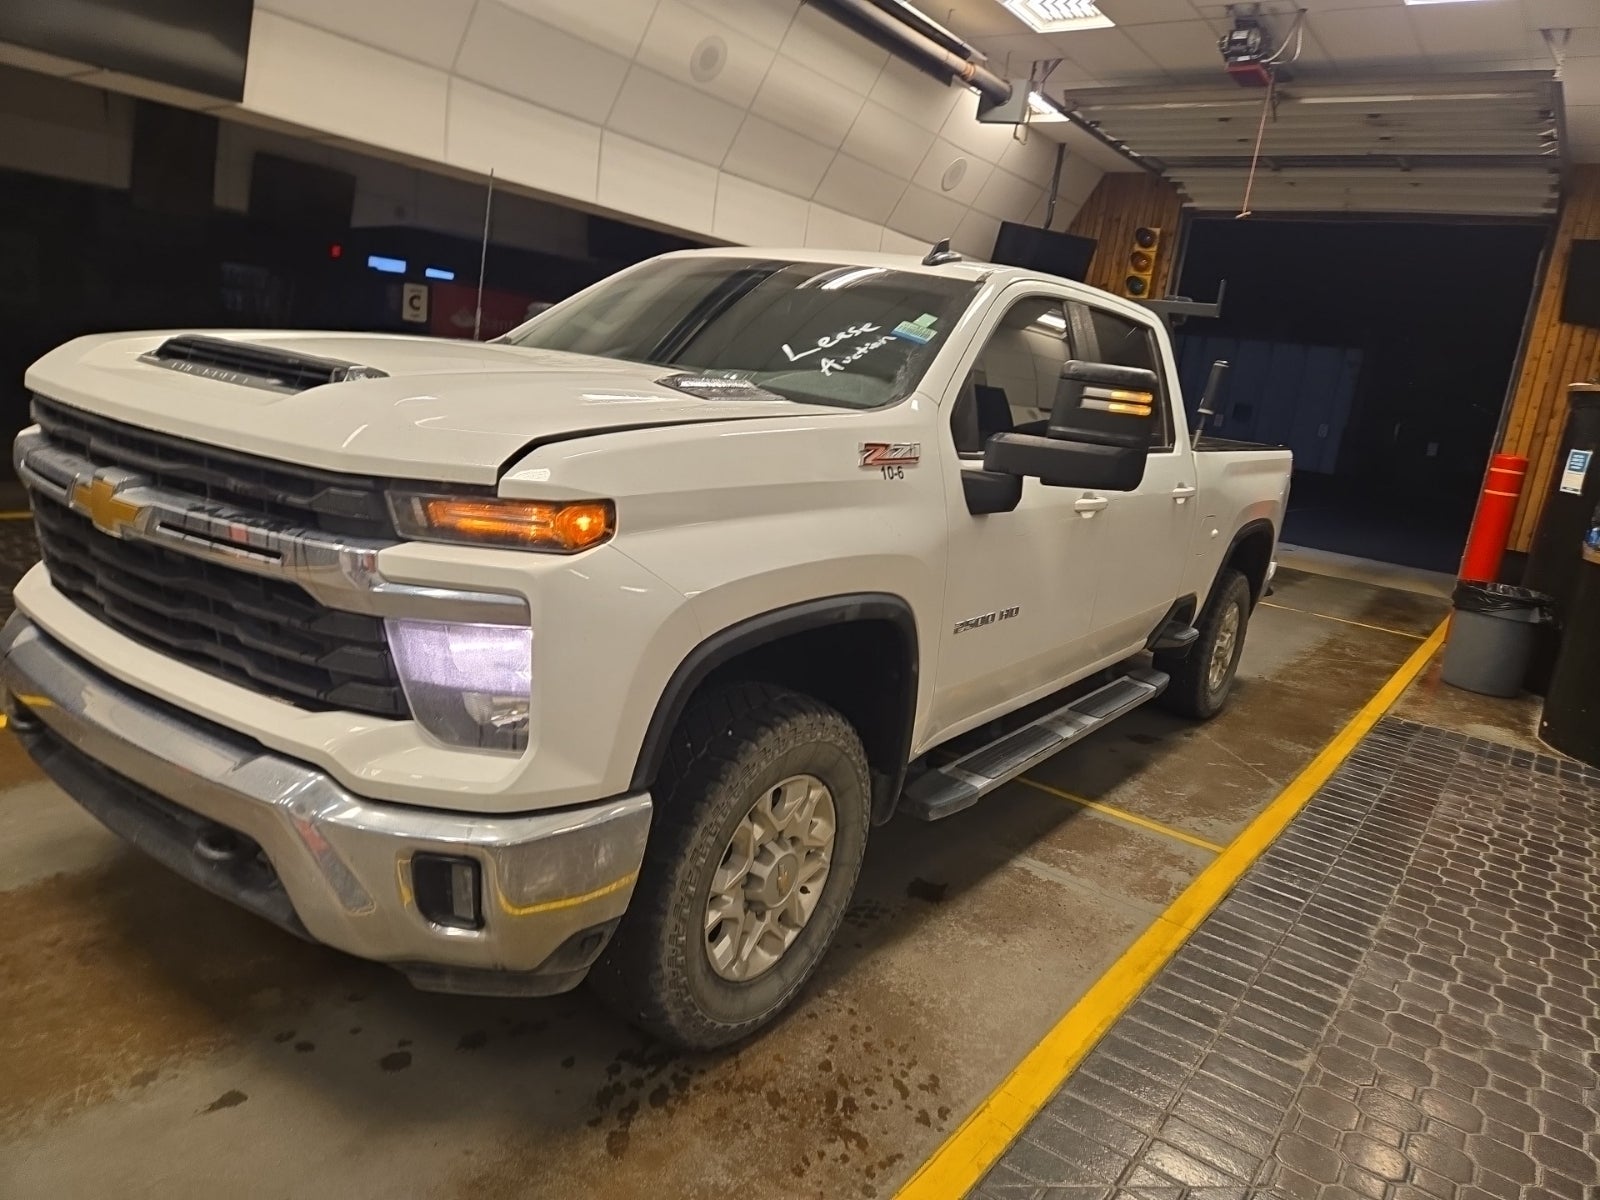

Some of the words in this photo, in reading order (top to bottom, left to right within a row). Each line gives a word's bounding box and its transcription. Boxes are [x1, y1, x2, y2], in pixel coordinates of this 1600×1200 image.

[409, 294, 422, 311] C
[781, 322, 882, 362] Lease
[820, 335, 898, 377] Auction
[859, 442, 920, 467] Z71
[881, 465, 904, 480] 10-6
[953, 612, 996, 634] 2500
[999, 606, 1020, 621] HD
